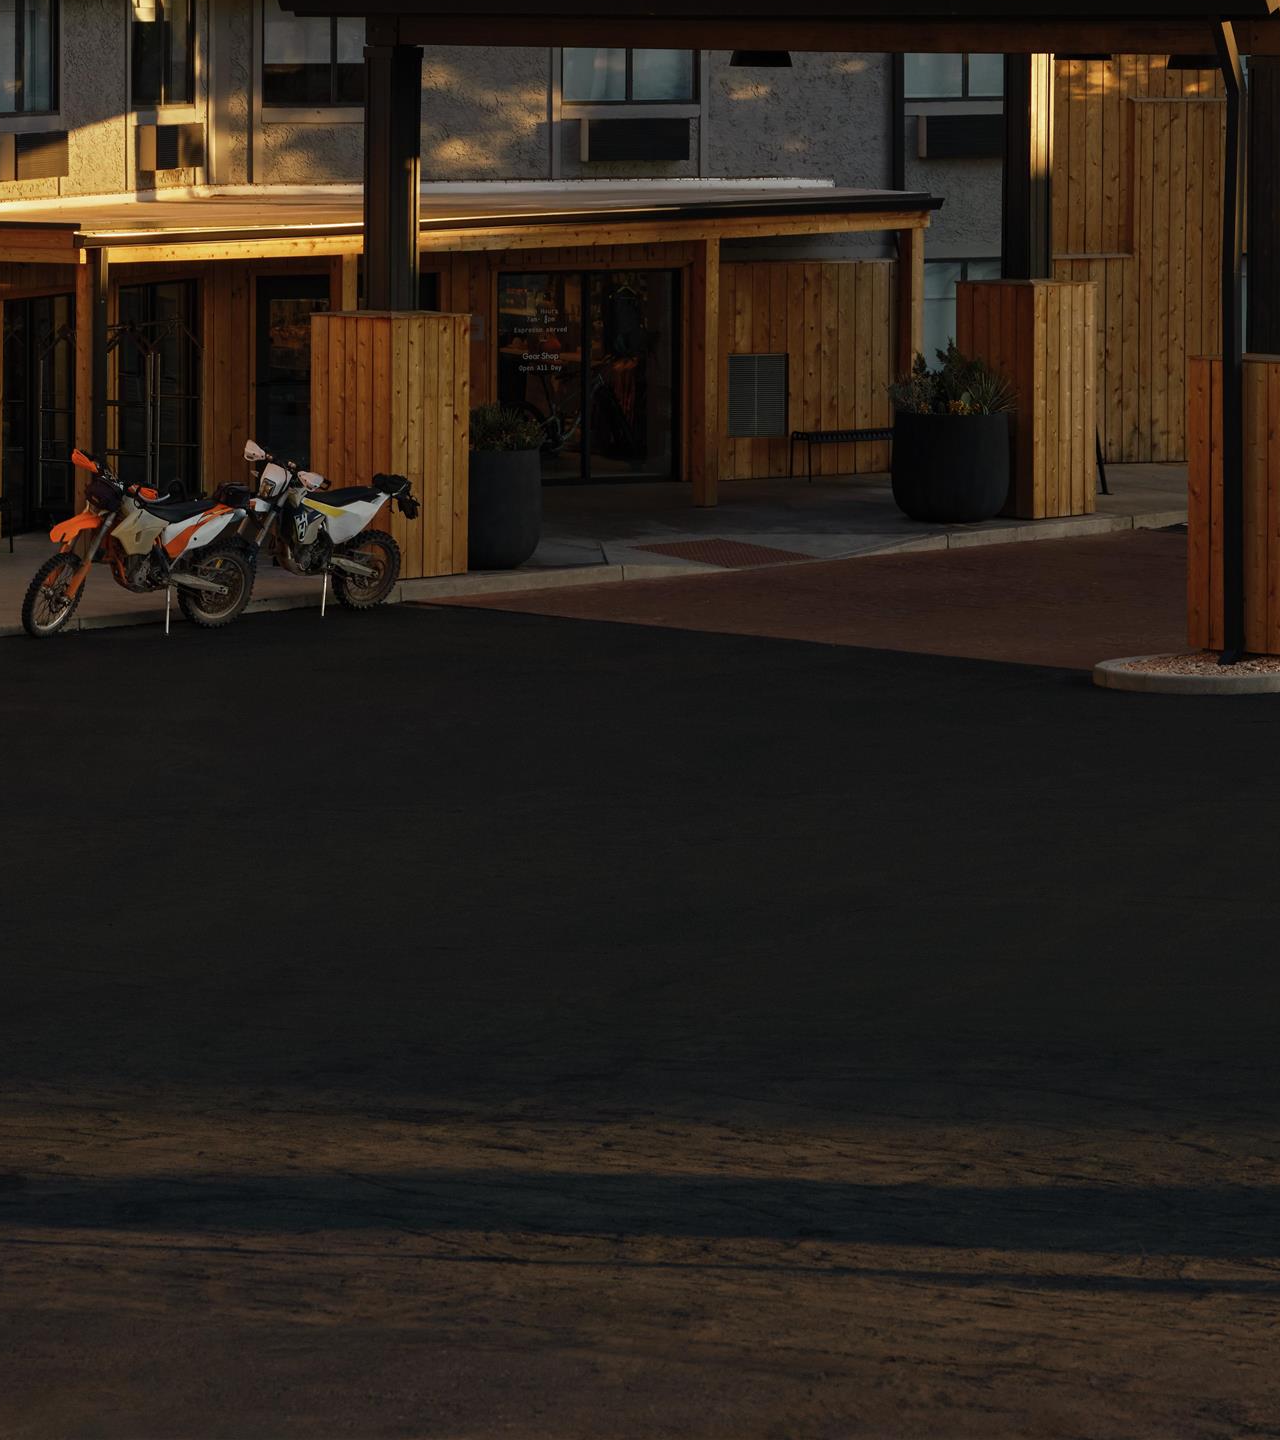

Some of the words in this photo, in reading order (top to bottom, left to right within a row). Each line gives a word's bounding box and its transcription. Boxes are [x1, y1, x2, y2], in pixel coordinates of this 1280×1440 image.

[522, 352, 539, 360] Gear
[540, 351, 559, 361] Shop
[518, 365, 535, 373] Open
